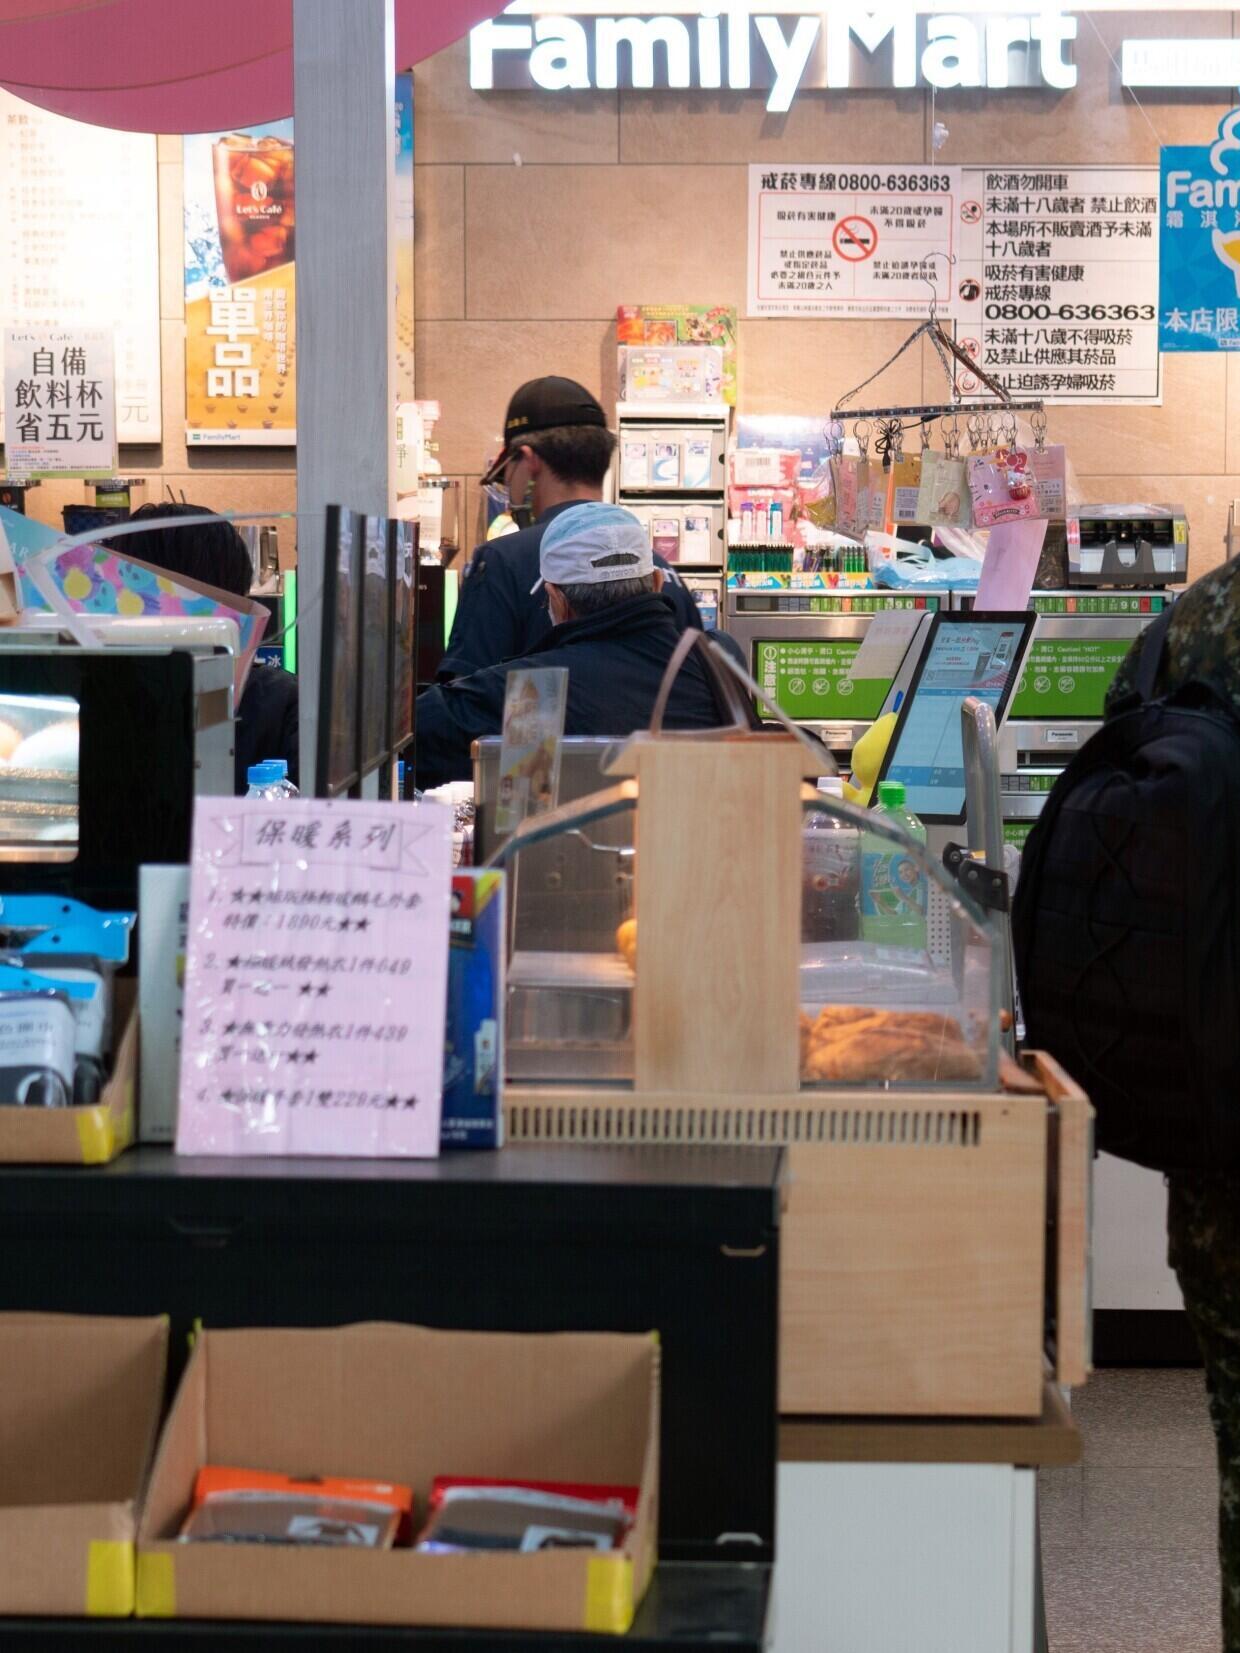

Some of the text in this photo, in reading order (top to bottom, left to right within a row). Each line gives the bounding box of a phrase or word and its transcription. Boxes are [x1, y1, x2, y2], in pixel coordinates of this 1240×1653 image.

[470, 5, 1077, 112] FamilyMart
[986, 174, 1069, 190] 飲酒勿開車
[986, 197, 1157, 213] 未滿十八歲者 禁止飲酒
[985, 220, 1152, 238] 本場所不販賣酒予未滿
[985, 241, 1051, 257] 十八歲者
[985, 264, 1084, 281] 吸菸有害健康
[985, 285, 1051, 301] 戒菸專線
[985, 303, 1155, 320] 0800-636363
[206, 287, 260, 397] 單品
[984, 328, 1132, 346] 未滿十八歲不得吸菸
[32, 346, 87, 376] 自備
[984, 349, 1116, 365] 及禁止供應其菸品
[14, 378, 104, 410] 飲料杯
[15, 412, 105, 444] 省五元
[255, 818, 396, 850] 保暖系列
